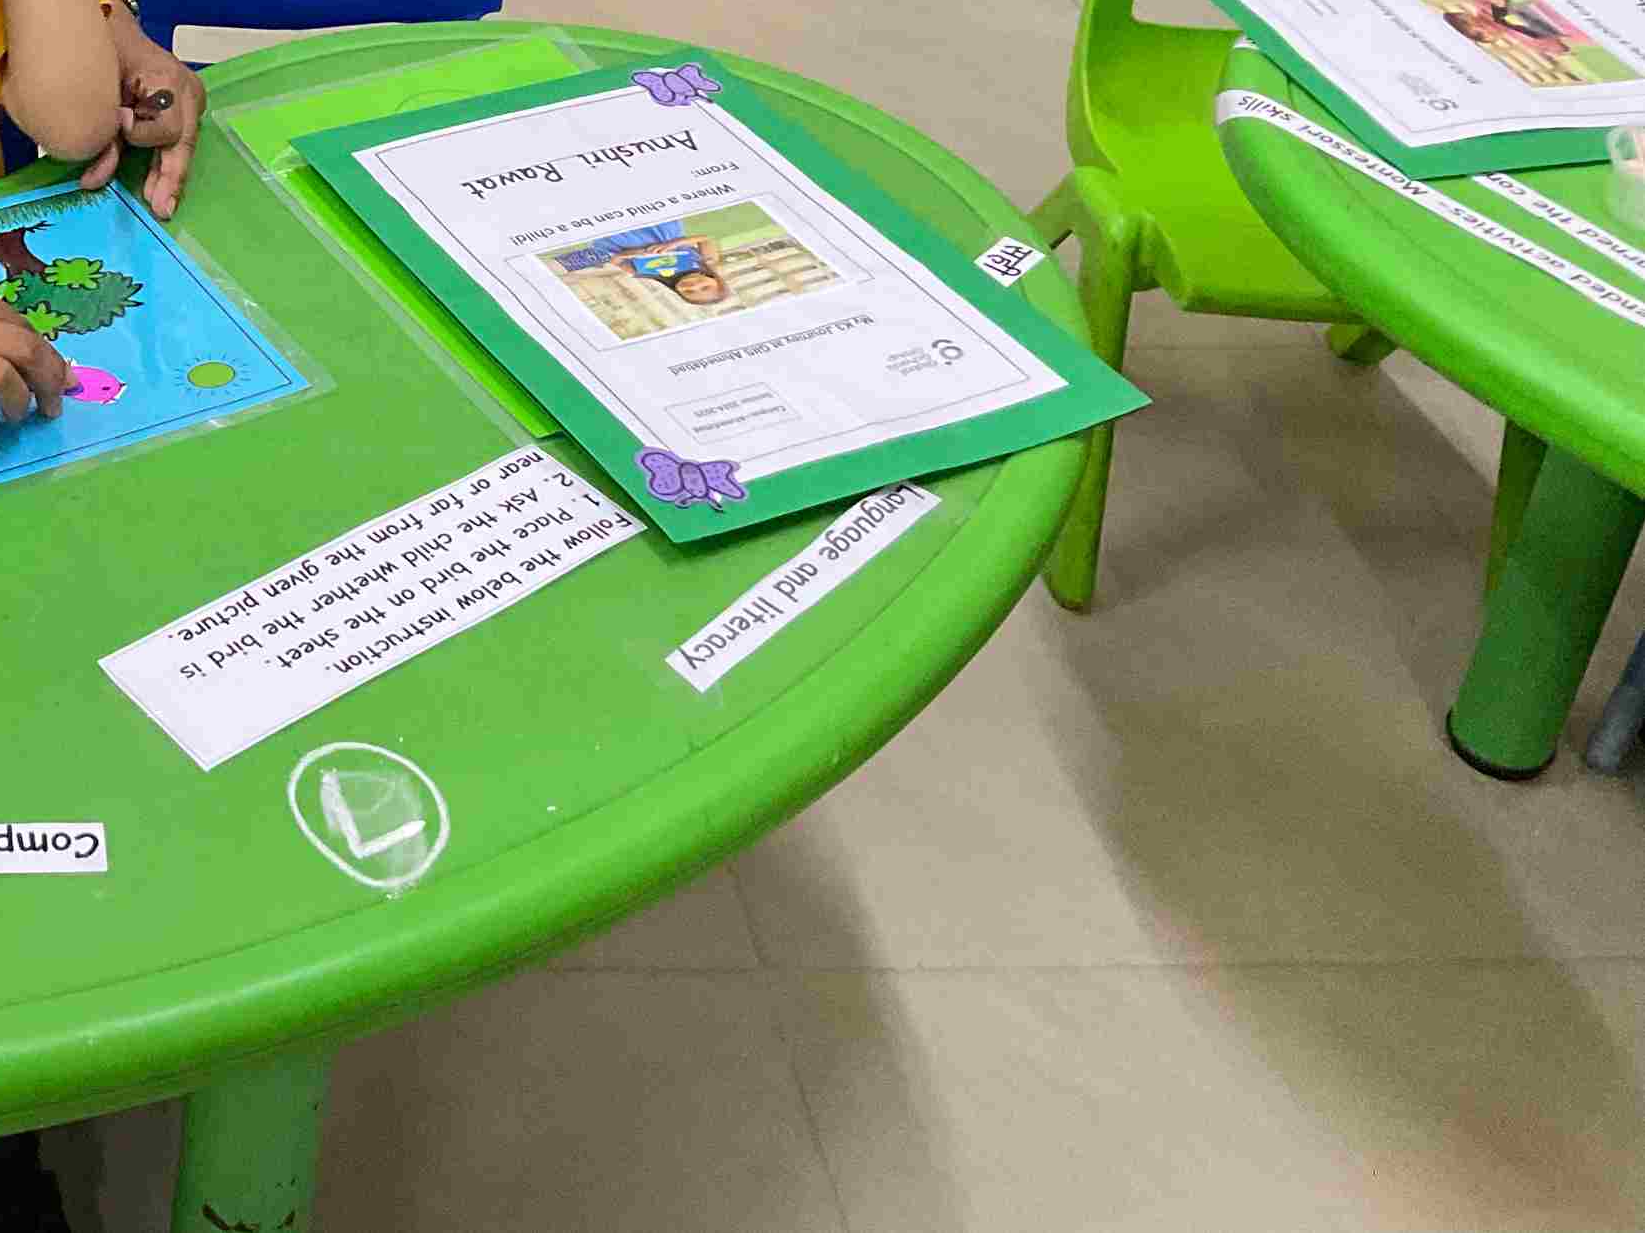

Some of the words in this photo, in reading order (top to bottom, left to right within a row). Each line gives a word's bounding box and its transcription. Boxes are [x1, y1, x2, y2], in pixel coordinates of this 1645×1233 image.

[1237, 95, 1294, 123] skills
[575, 129, 698, 169] Anushri
[1299, 125, 1426, 195] Montessori
[460, 161, 564, 200] Rawat
[690, 162, 740, 177] From:
[666, 196, 680, 205] a
[680, 183, 736, 201] Where
[592, 209, 625, 223] can
[625, 200, 666, 217] child
[1532, 202, 1572, 226] the
[554, 223, 569, 232] a
[570, 217, 595, 228] be
[509, 227, 556, 247] child!
[498, 451, 545, 480] near
[469, 478, 491, 496] or
[543, 471, 574, 487] 2.
[429, 492, 465, 517] far
[497, 487, 538, 513] Ask
[571, 493, 600, 507] 1.
[366, 512, 424, 544] from
[456, 510, 498, 533] the
[512, 506, 574, 539] Place
[562, 511, 633, 550] Follow
[818, 482, 925, 561] Language
[324, 542, 366, 566] the
[400, 532, 453, 568] child
[469, 538, 512, 563] the
[518, 548, 561, 572] the
[261, 558, 320, 598] given
[311, 560, 399, 613] whether
[419, 561, 473, 595] bird
[455, 570, 523, 610] below
[772, 562, 819, 603] and
[386, 588, 416, 607] on
[167, 589, 260, 641] picture.
[261, 610, 305, 635] the
[343, 605, 386, 630] the
[325, 607, 456, 673] instruction.
[677, 596, 784, 671] literacy
[206, 633, 263, 669] bird
[265, 627, 340, 668] sheet.
[179, 661, 207, 679] is
